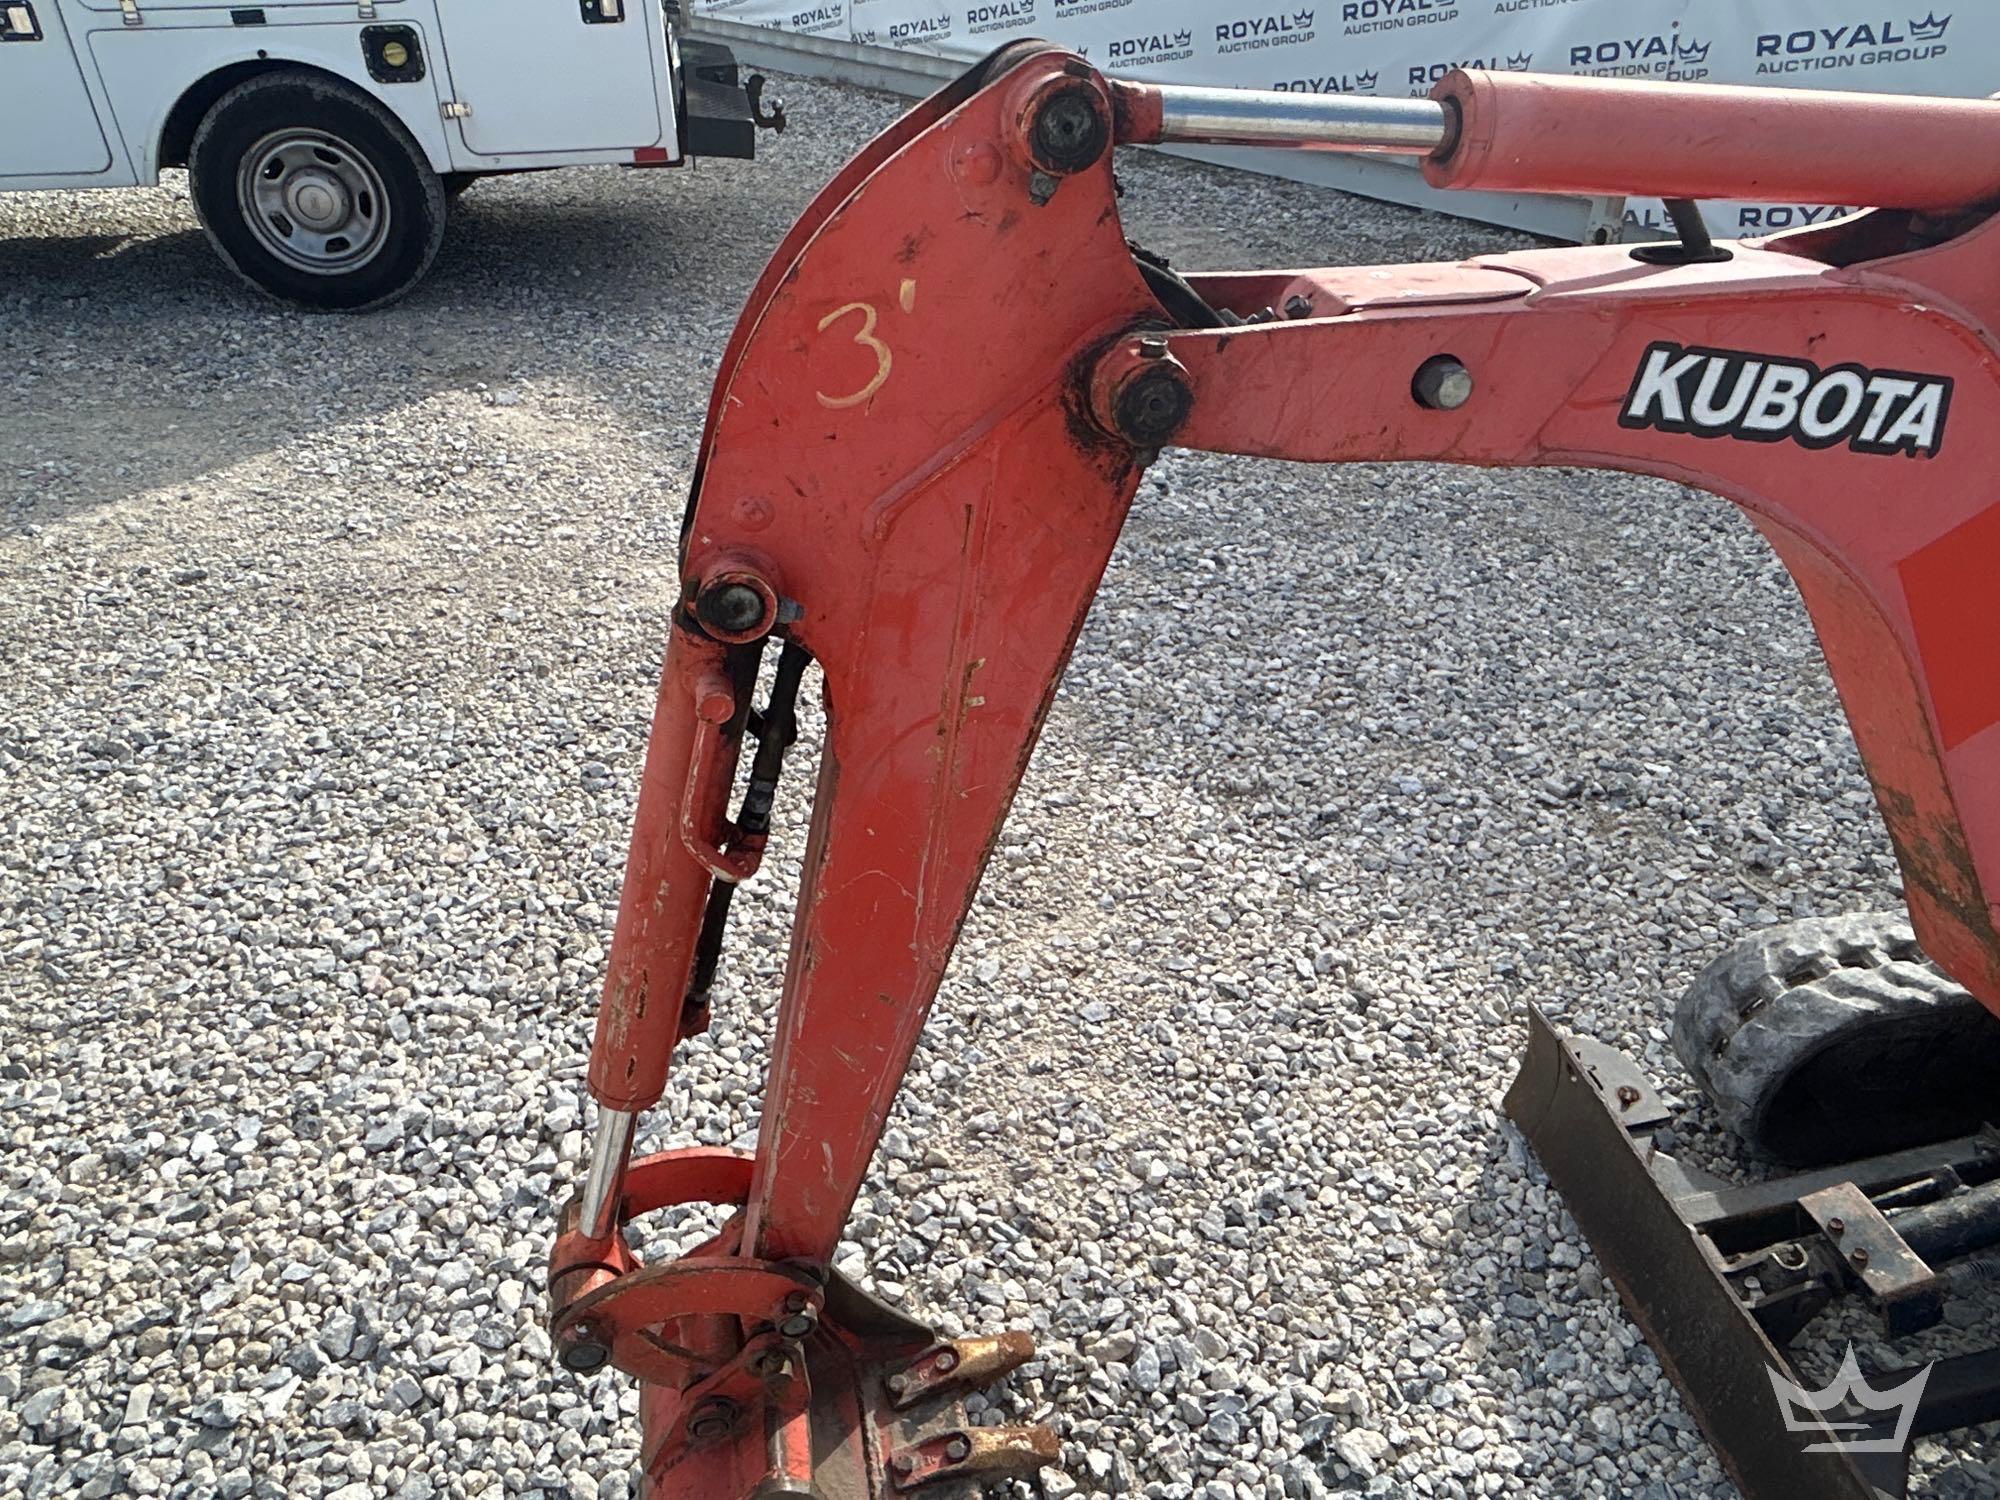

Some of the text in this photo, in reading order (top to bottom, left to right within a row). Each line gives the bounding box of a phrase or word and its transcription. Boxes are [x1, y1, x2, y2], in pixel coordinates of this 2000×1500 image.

[792, 8, 832, 27] ROYAL
[966, 3, 1020, 24] ROYAL
[1056, 3, 1097, 18] AUCTION
[889, 18, 938, 38] ROYAL
[968, 15, 1036, 35] AUCTION GROUP
[1216, 15, 1293, 41] ROYAL
[1343, 10, 1459, 36] AUCTION GROUP
[1109, 34, 1174, 58] ROYAL
[1217, 31, 1316, 55] AUCTION GROUP
[1756, 21, 1904, 57] ROYAL
[1108, 49, 1194, 70] AUCTION GROUP
[1755, 44, 1948, 75] AUCTION GROUP
[1738, 206, 1851, 228] ROYA
[1626, 348, 1946, 449] KUBOTA
